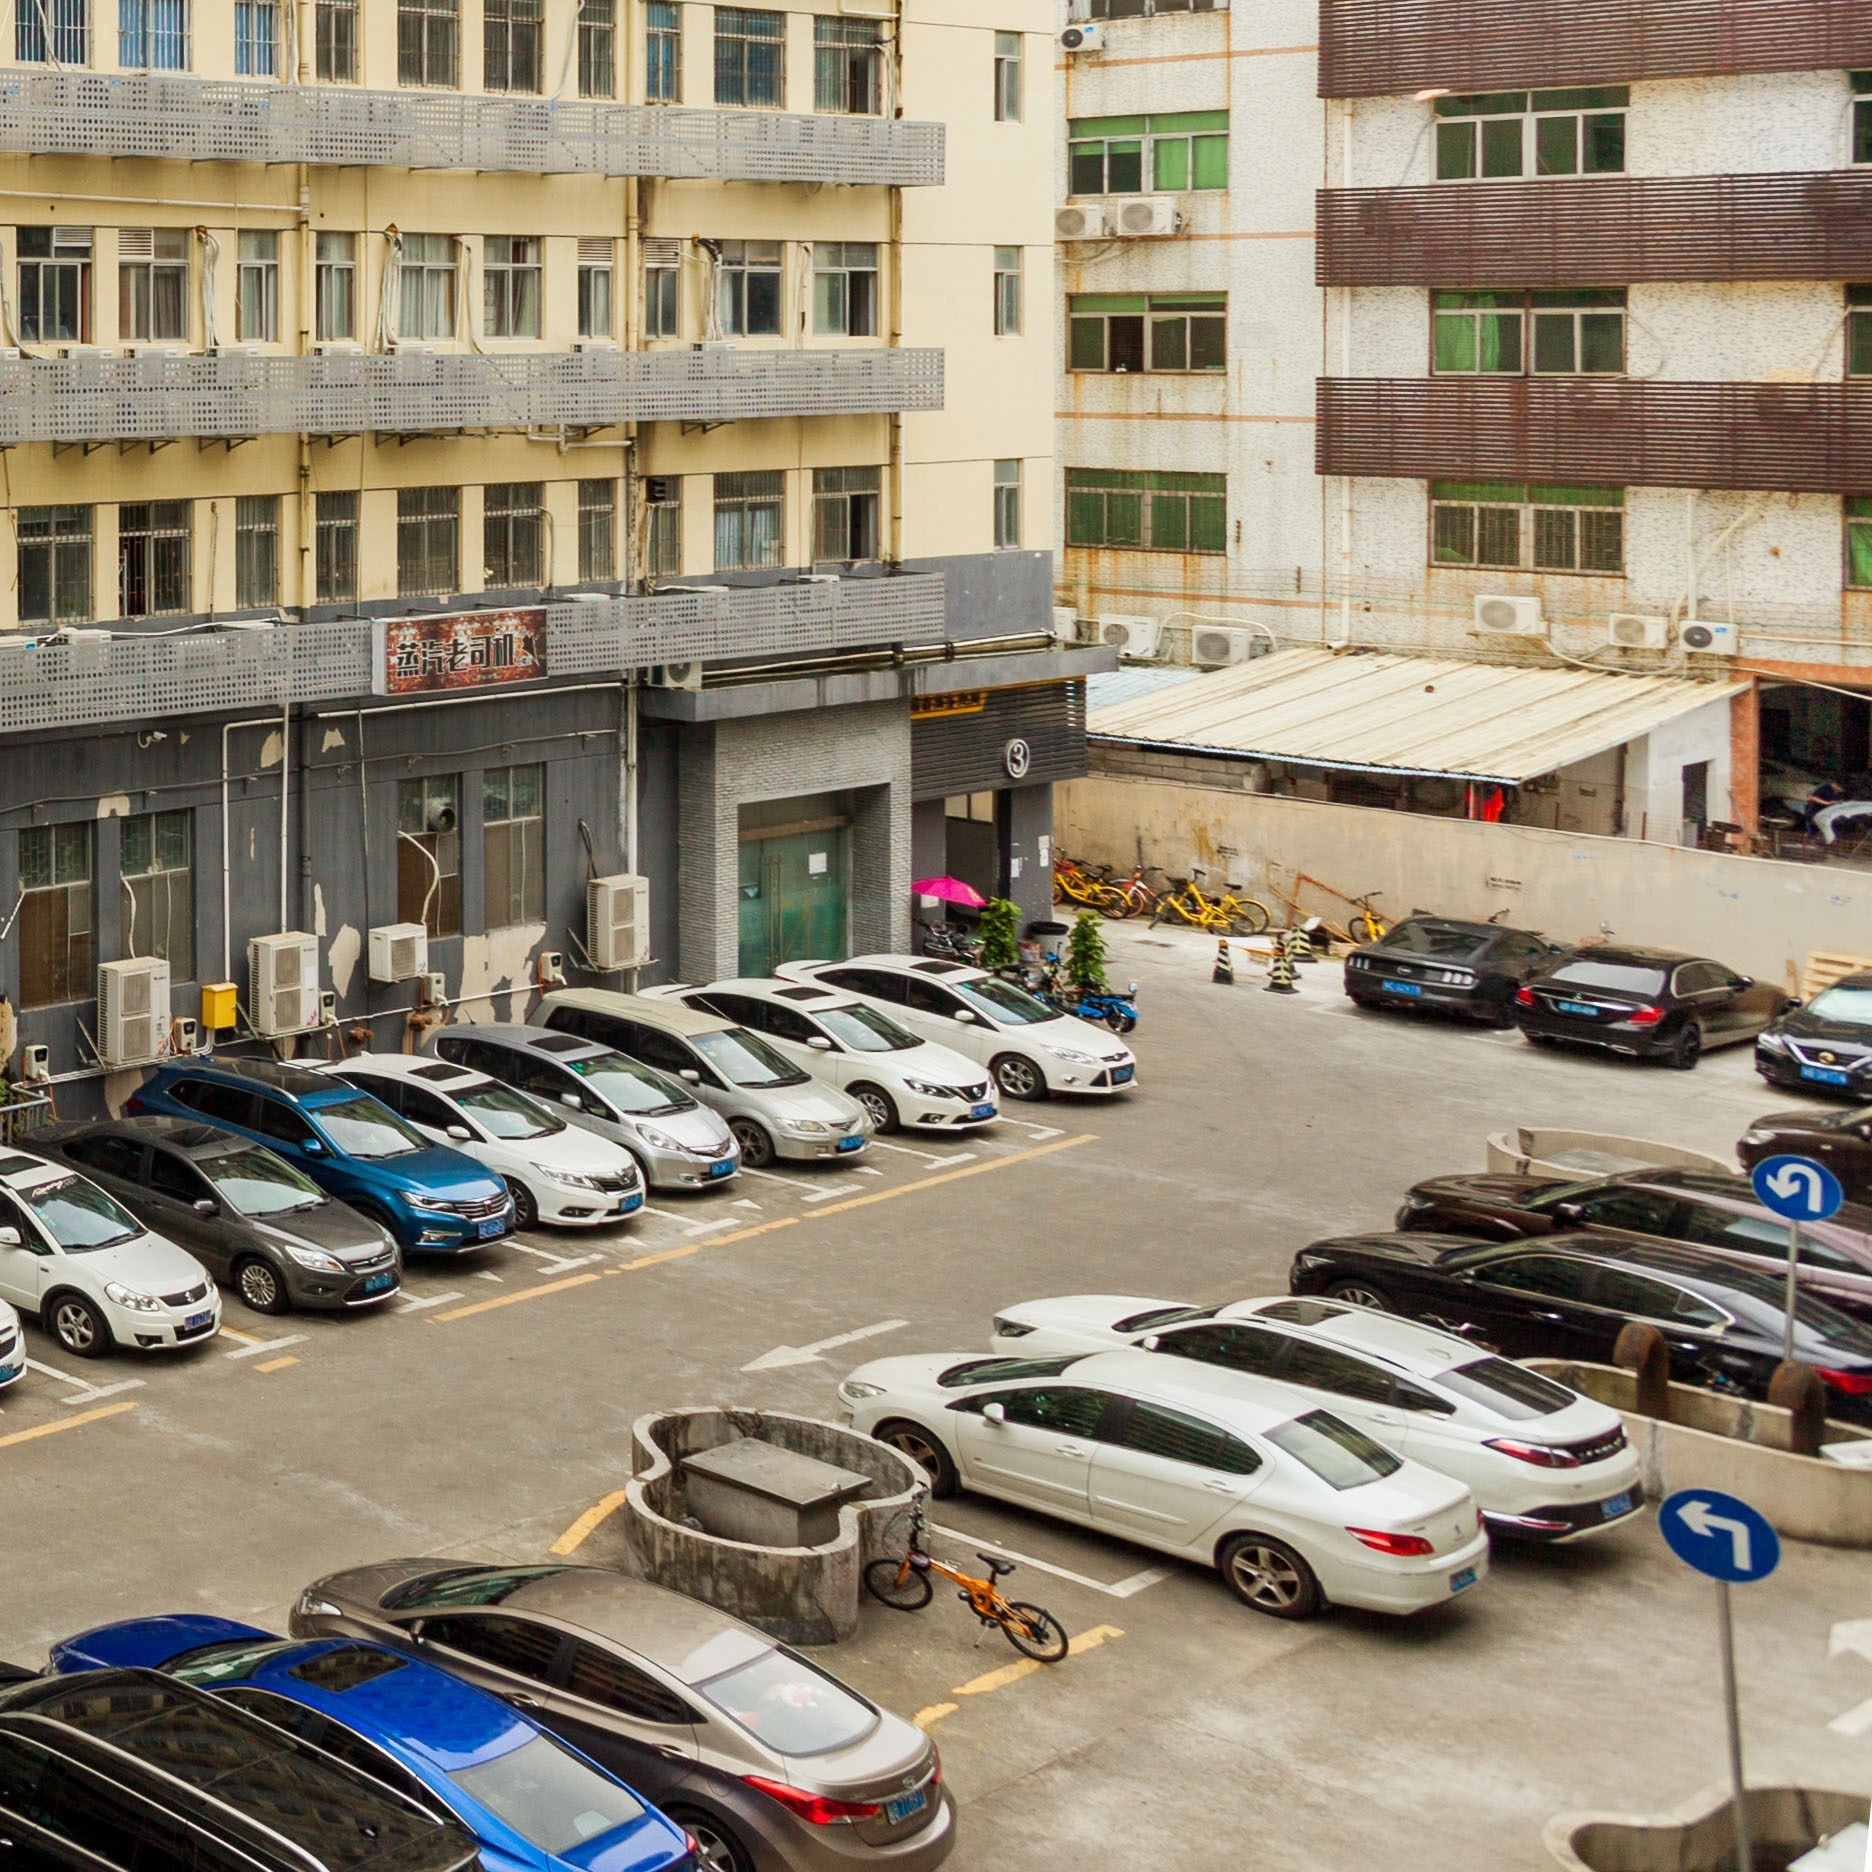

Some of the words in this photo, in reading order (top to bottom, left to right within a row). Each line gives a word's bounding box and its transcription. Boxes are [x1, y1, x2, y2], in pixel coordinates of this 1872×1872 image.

[397, 633, 514, 677] 蒸汽老司机
